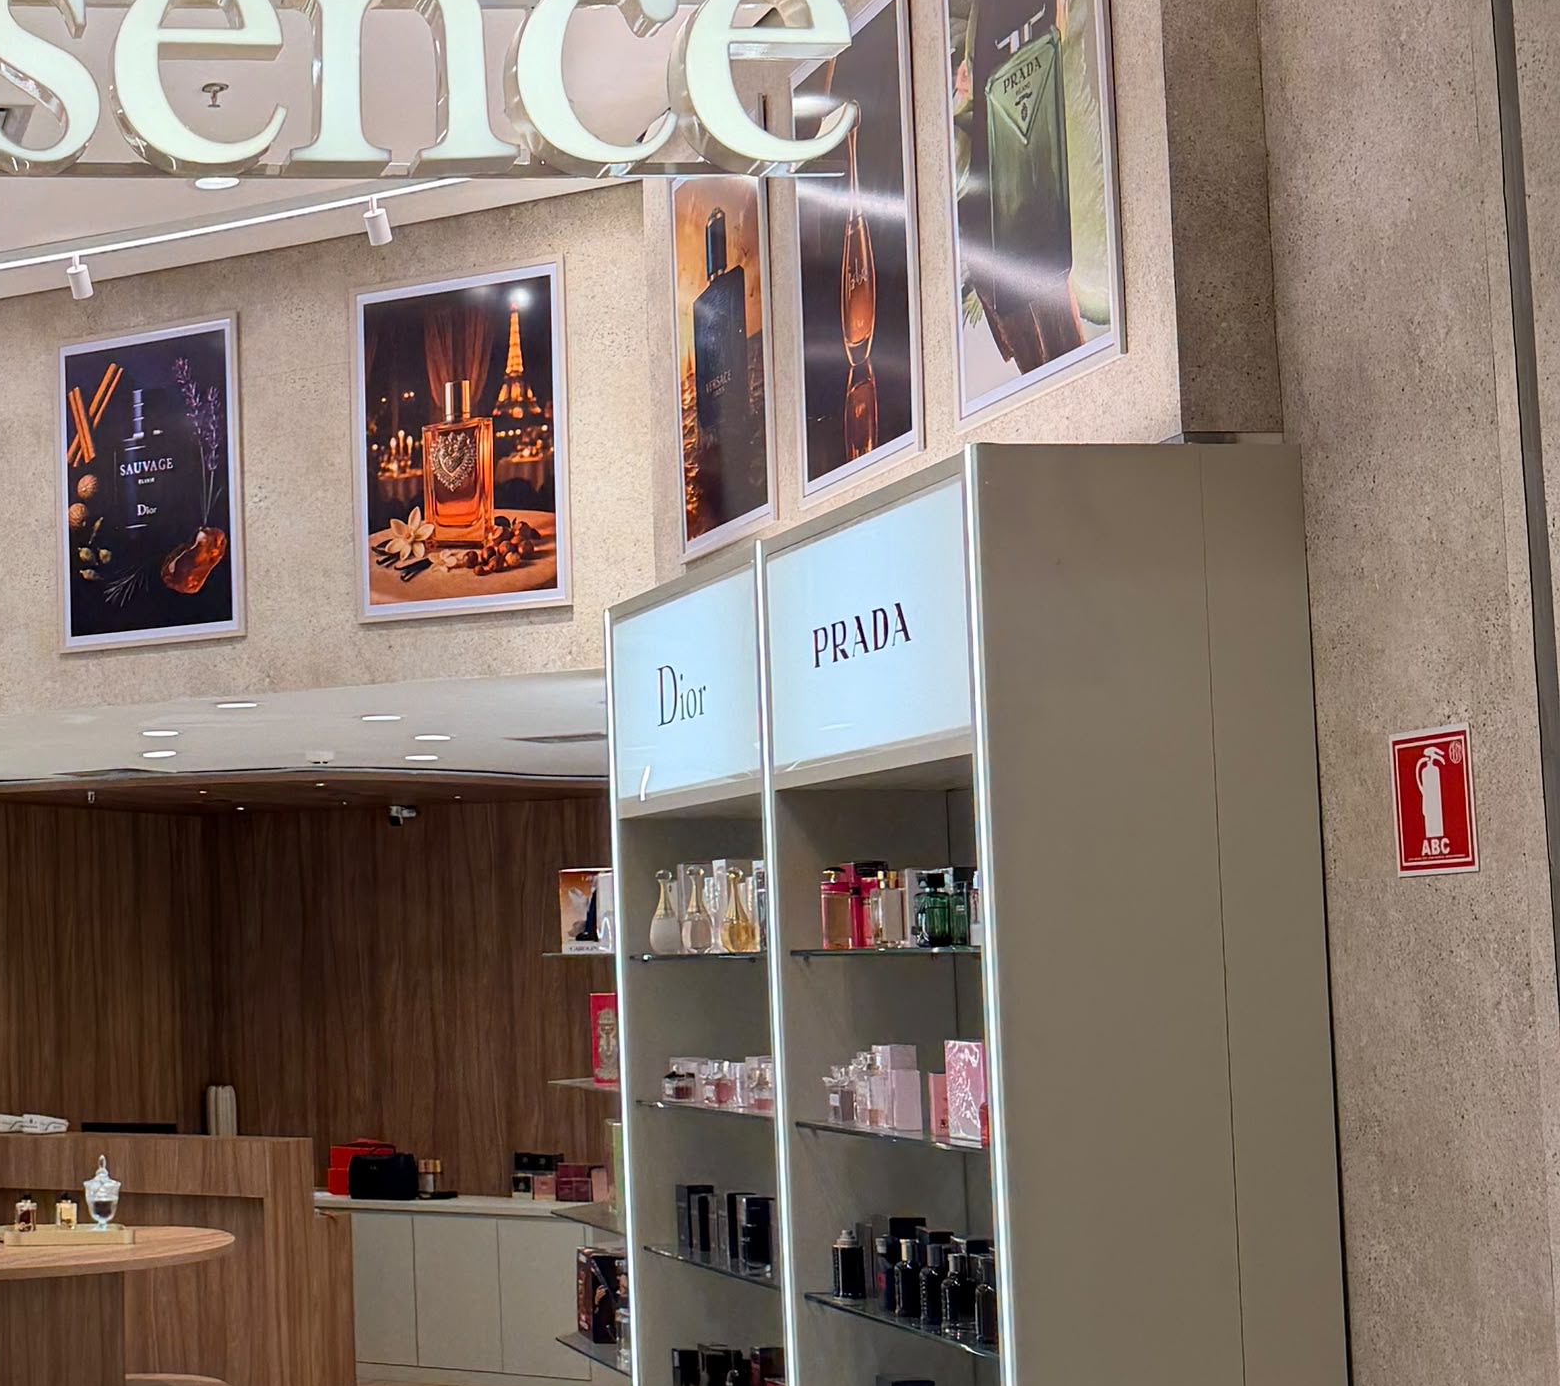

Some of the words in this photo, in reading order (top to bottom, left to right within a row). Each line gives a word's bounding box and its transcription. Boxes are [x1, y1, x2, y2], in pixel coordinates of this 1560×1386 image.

[1003, 57, 1041, 94] PRADA
[120, 458, 174, 476] SAUVAGE
[137, 504, 158, 517] Dior
[812, 602, 912, 669] PRADA
[656, 664, 707, 727] Dior
[1421, 838, 1451, 856] ABC
